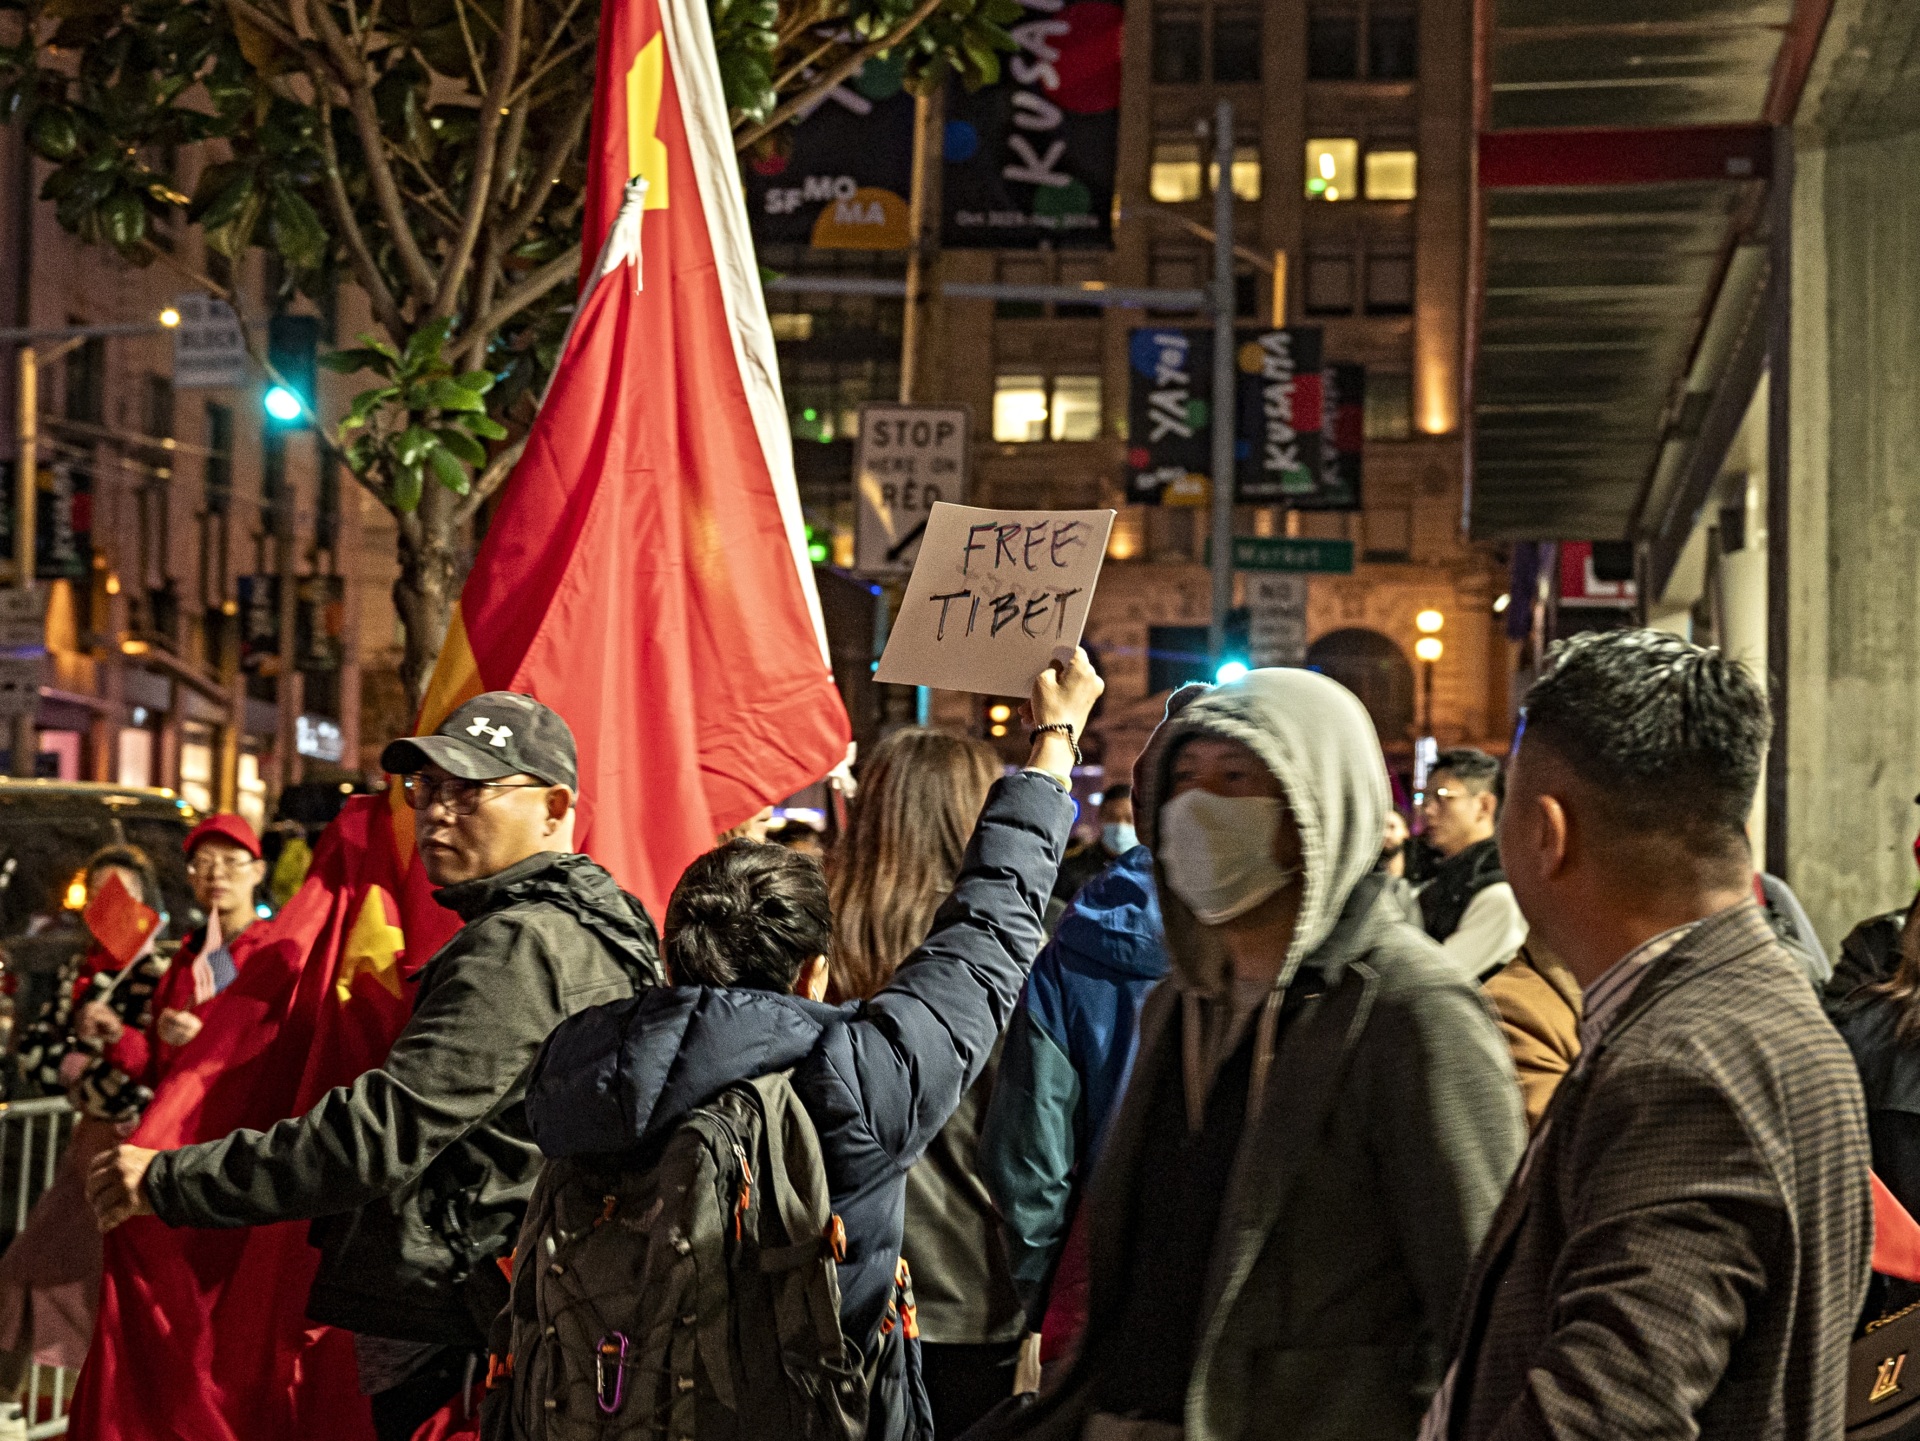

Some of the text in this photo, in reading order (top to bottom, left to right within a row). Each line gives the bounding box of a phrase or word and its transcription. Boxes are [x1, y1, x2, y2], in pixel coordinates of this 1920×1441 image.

[1002, 0, 1071, 187] KUSA
[873, 420, 955, 448] STOP
[867, 456, 957, 474] HERE ON
[882, 480, 942, 512] RED
[963, 519, 1081, 576] FREE
[929, 586, 1083, 642] TIBET
